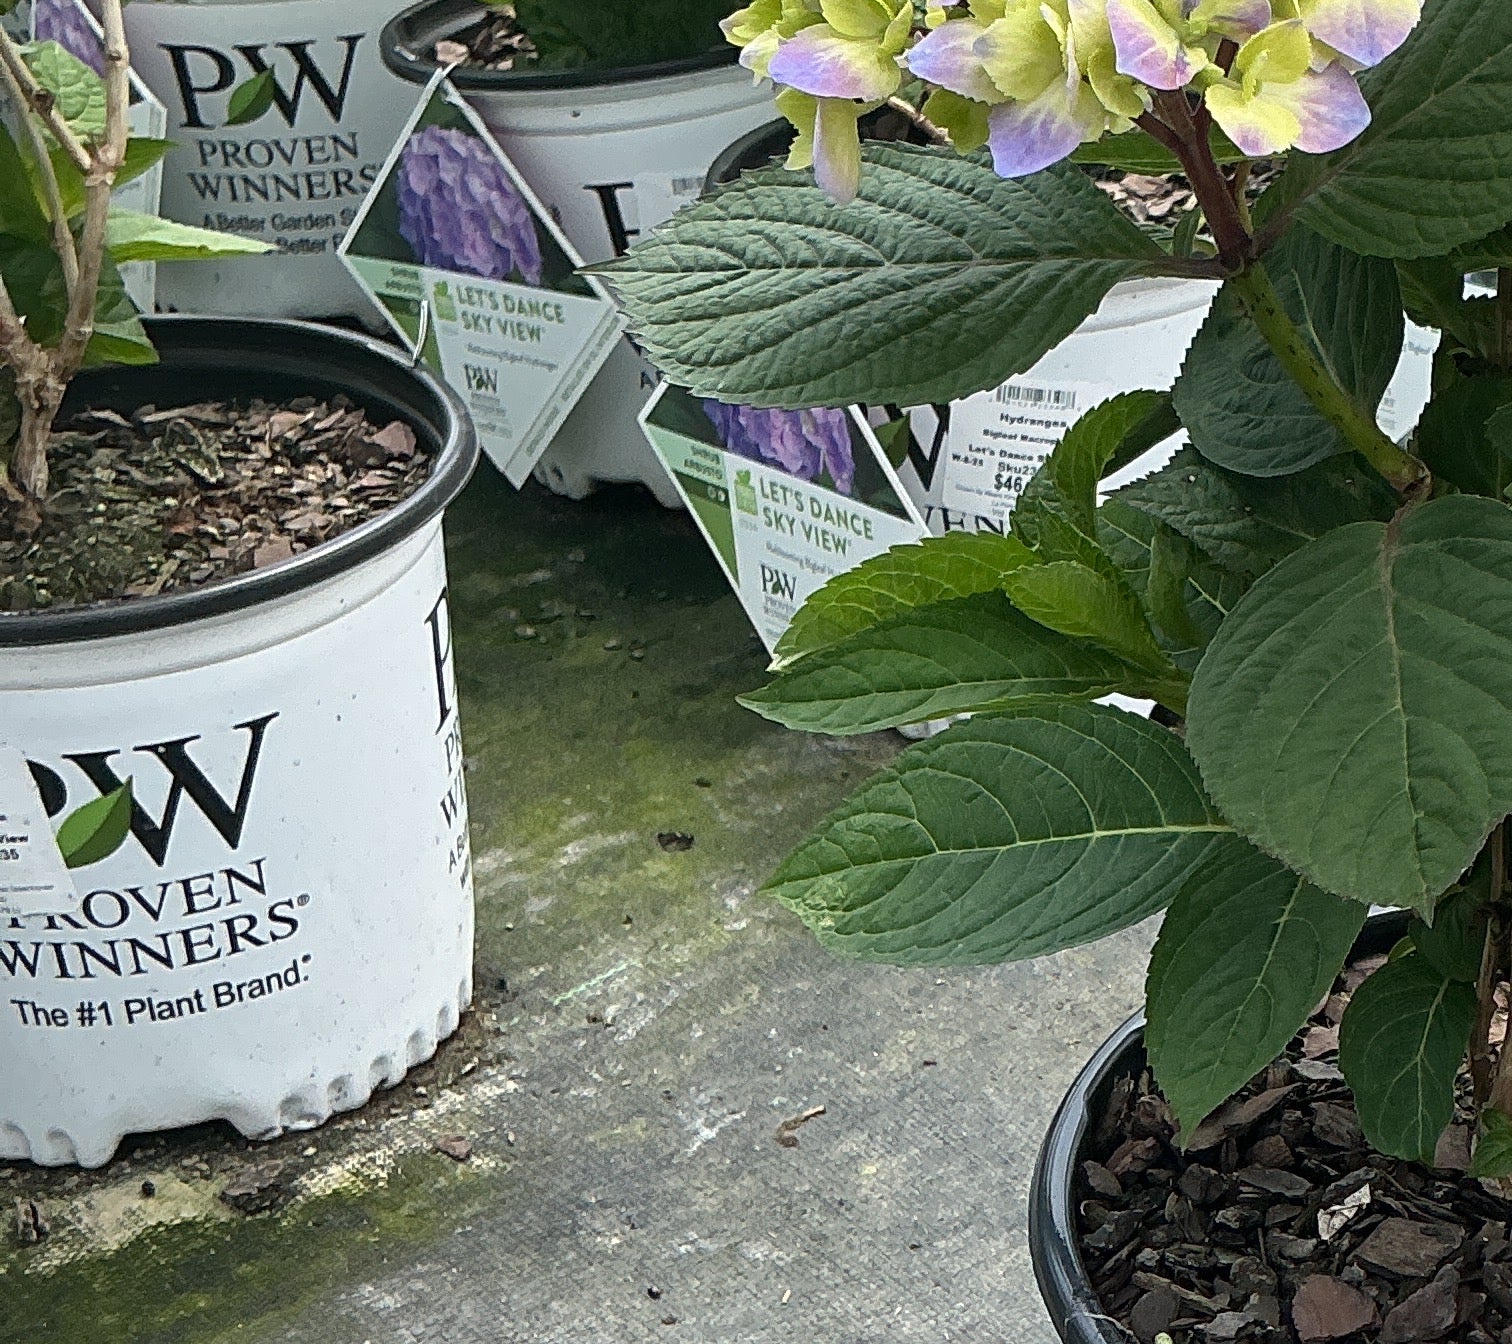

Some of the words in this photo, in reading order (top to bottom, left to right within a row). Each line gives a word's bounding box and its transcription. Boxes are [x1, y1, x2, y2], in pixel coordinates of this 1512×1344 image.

[157, 32, 366, 130] PW
[196, 131, 359, 168] PROVEN
[272, 212, 336, 232] Garden
[461, 310, 492, 334] SKY
[502, 294, 565, 324] DANCE
[994, 473, 1023, 493] $46
[759, 476, 804, 513] LET'S
[809, 497, 874, 541] DANCE
[762, 506, 796, 537] SKY
[10, 998, 69, 1028] The
[77, 1001, 114, 1028] #1
[125, 988, 208, 1025] Plant
